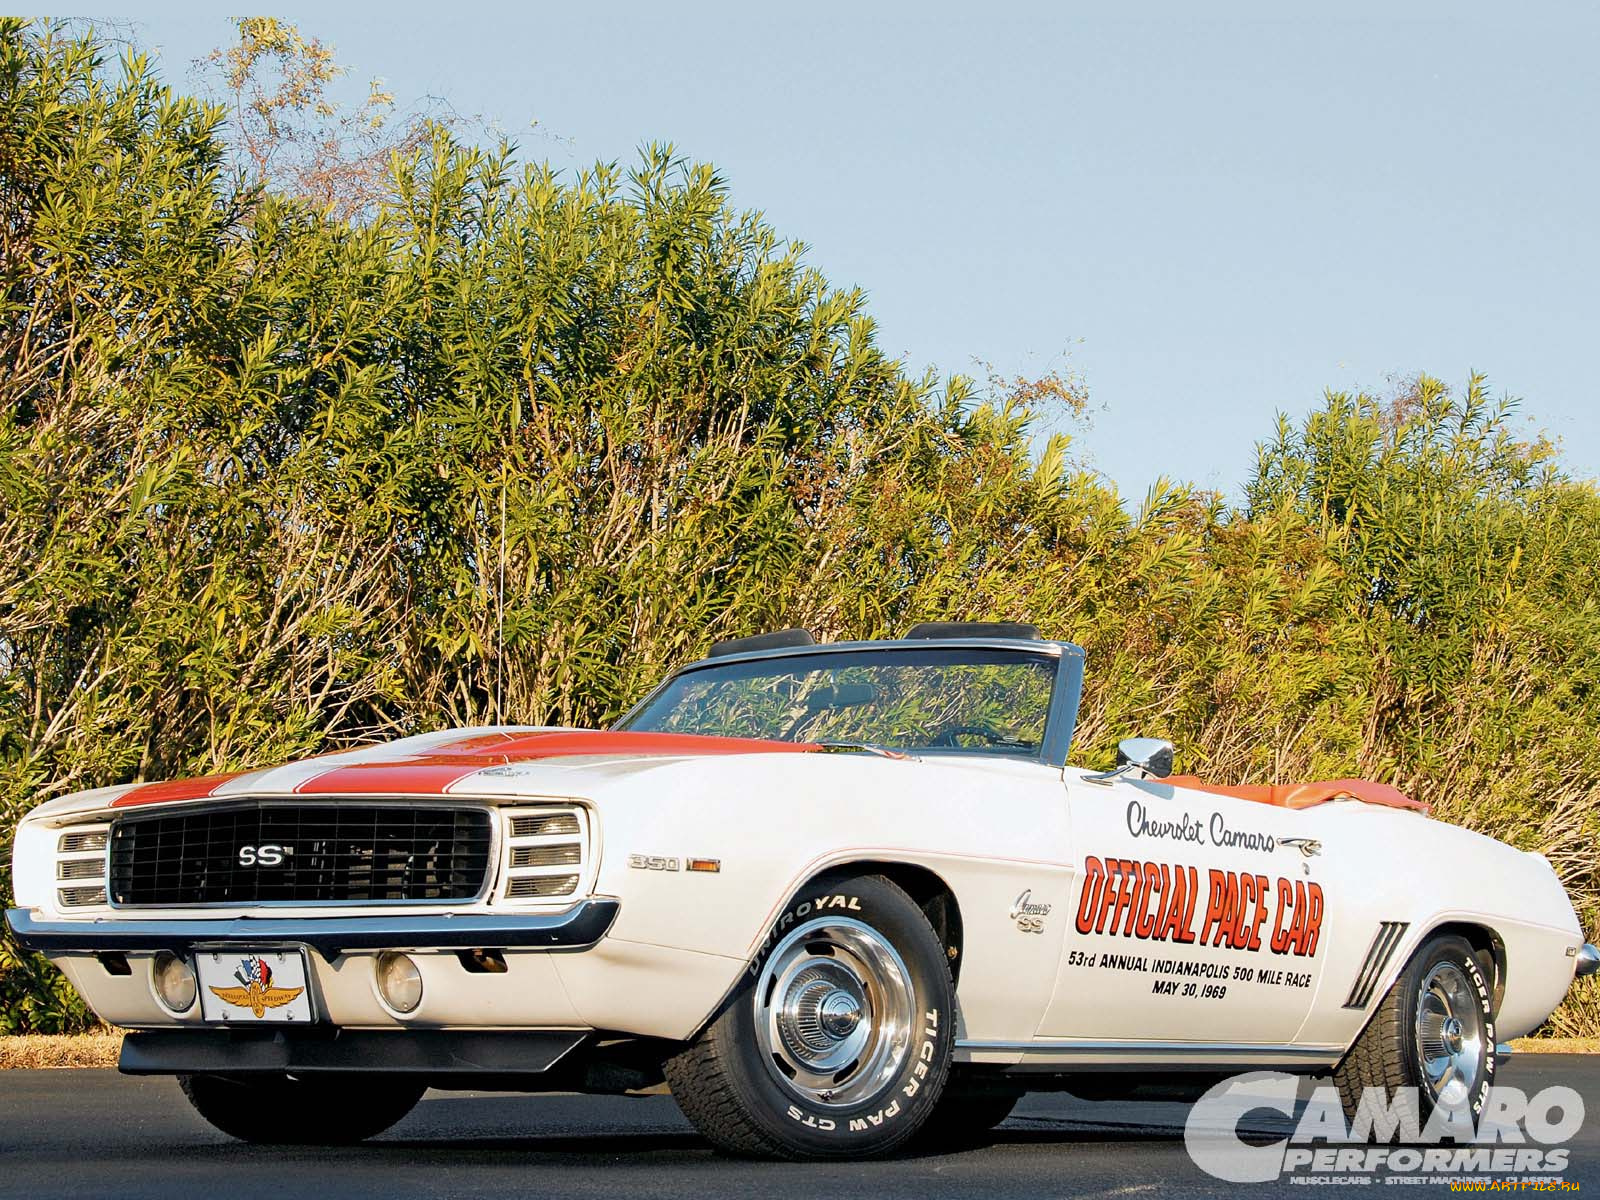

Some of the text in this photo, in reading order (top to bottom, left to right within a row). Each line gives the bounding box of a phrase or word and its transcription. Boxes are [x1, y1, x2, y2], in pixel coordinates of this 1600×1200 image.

[1126, 800, 1275, 853] Chevrolet Camaro
[239, 845, 282, 866] SS
[629, 853, 680, 872] 350
[1075, 855, 1325, 957] OFFICIAL PACE CAR
[1017, 917, 1045, 935] SS
[1068, 951, 1313, 988] 53rd ANNUAL INDIANAPOLIS 500 MILE RACE
[1151, 980, 1181, 995] MAY
[1465, 956, 1492, 1014] TIGER
[1484, 1022, 1496, 1076] PAW
[786, 1009, 938, 1132] TIGER PAW GTS
